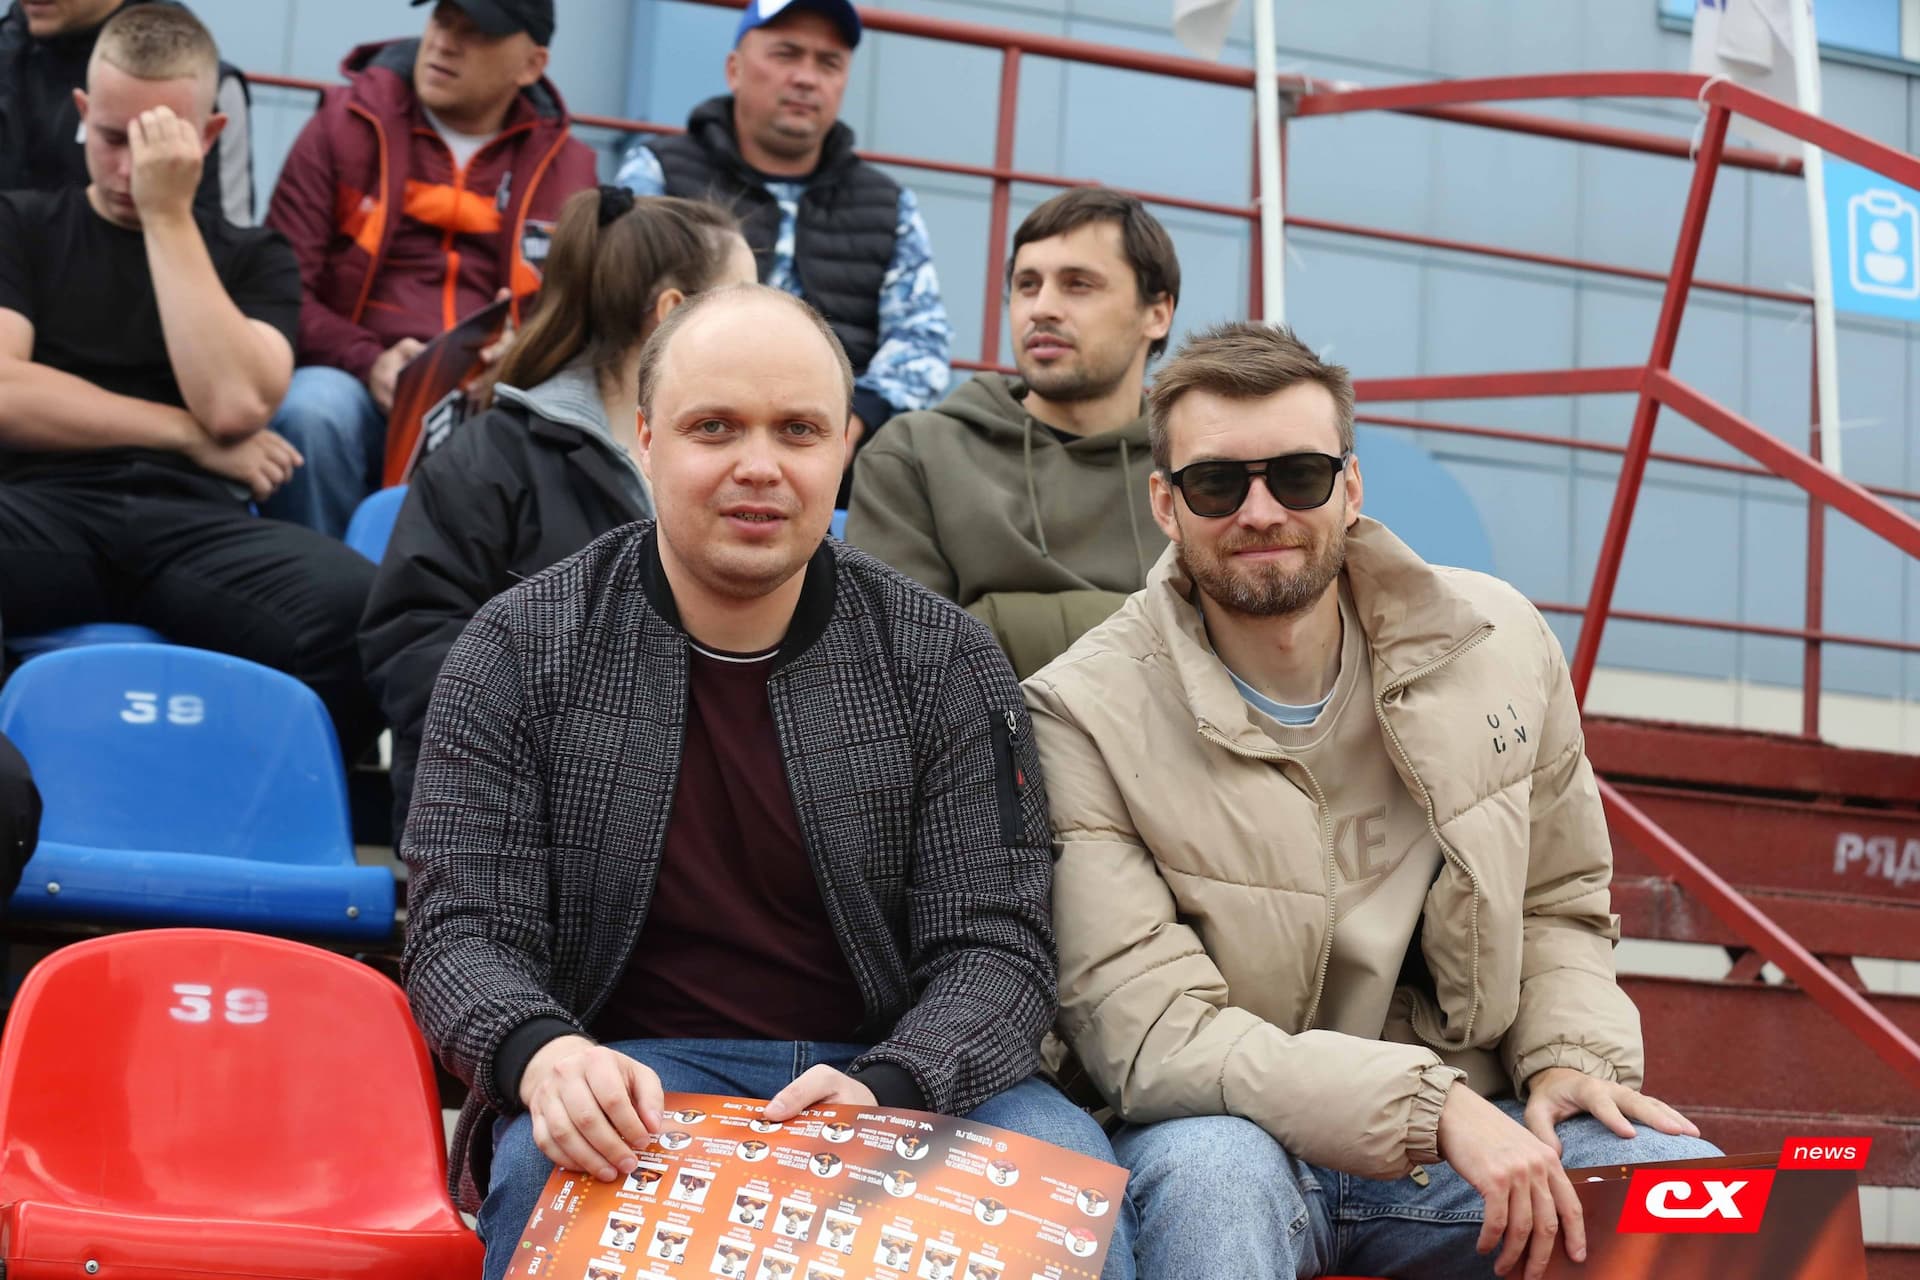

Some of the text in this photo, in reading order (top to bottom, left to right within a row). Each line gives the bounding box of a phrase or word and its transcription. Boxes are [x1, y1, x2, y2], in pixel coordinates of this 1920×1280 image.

[120, 691, 205, 725] 39
[1332, 803, 1389, 882] KE
[1833, 831, 1920, 889] РЯД
[168, 982, 270, 1025] 39
[553, 1180, 574, 1210] SEUS
